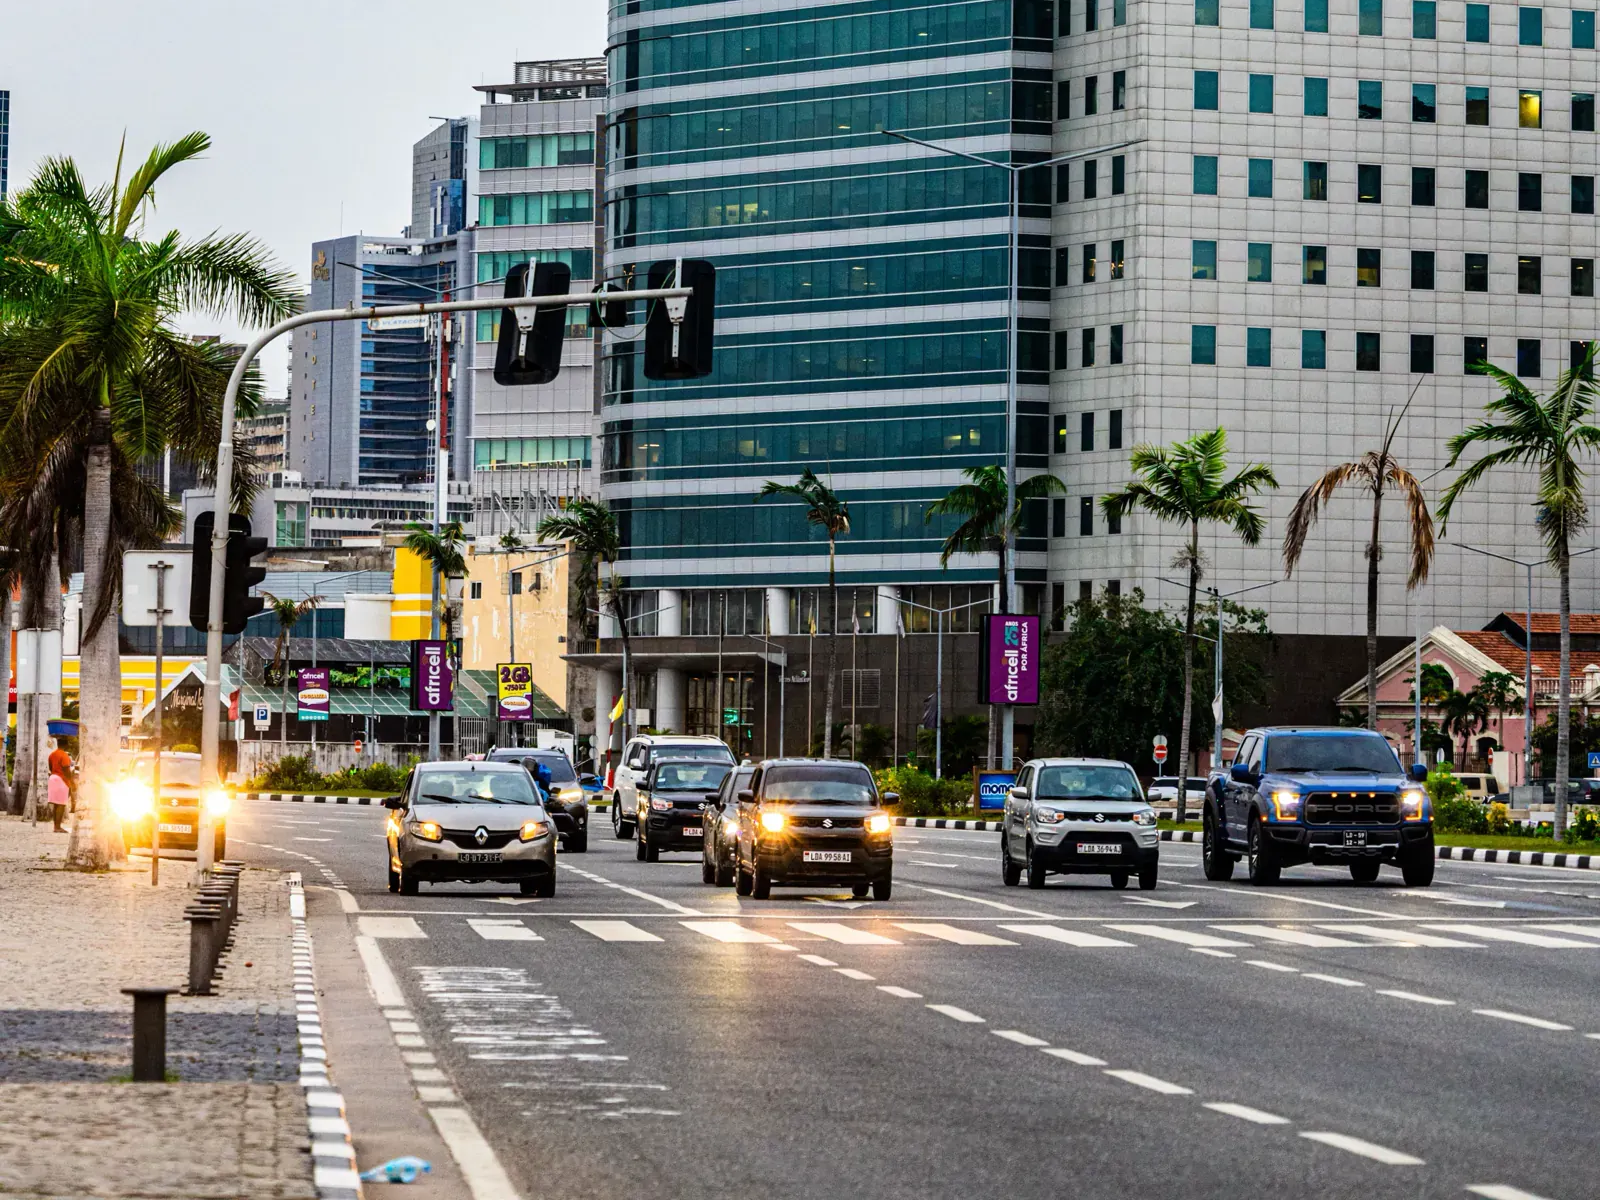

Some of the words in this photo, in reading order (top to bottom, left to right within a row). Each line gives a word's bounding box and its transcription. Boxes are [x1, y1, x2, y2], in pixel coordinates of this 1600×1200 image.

[1020, 621, 1028, 653] ÁFRICA
[424, 646, 441, 705] africell
[1004, 649, 1019, 702] africell
[259, 710, 266, 720] P
[1308, 804, 1398, 813] FORD
